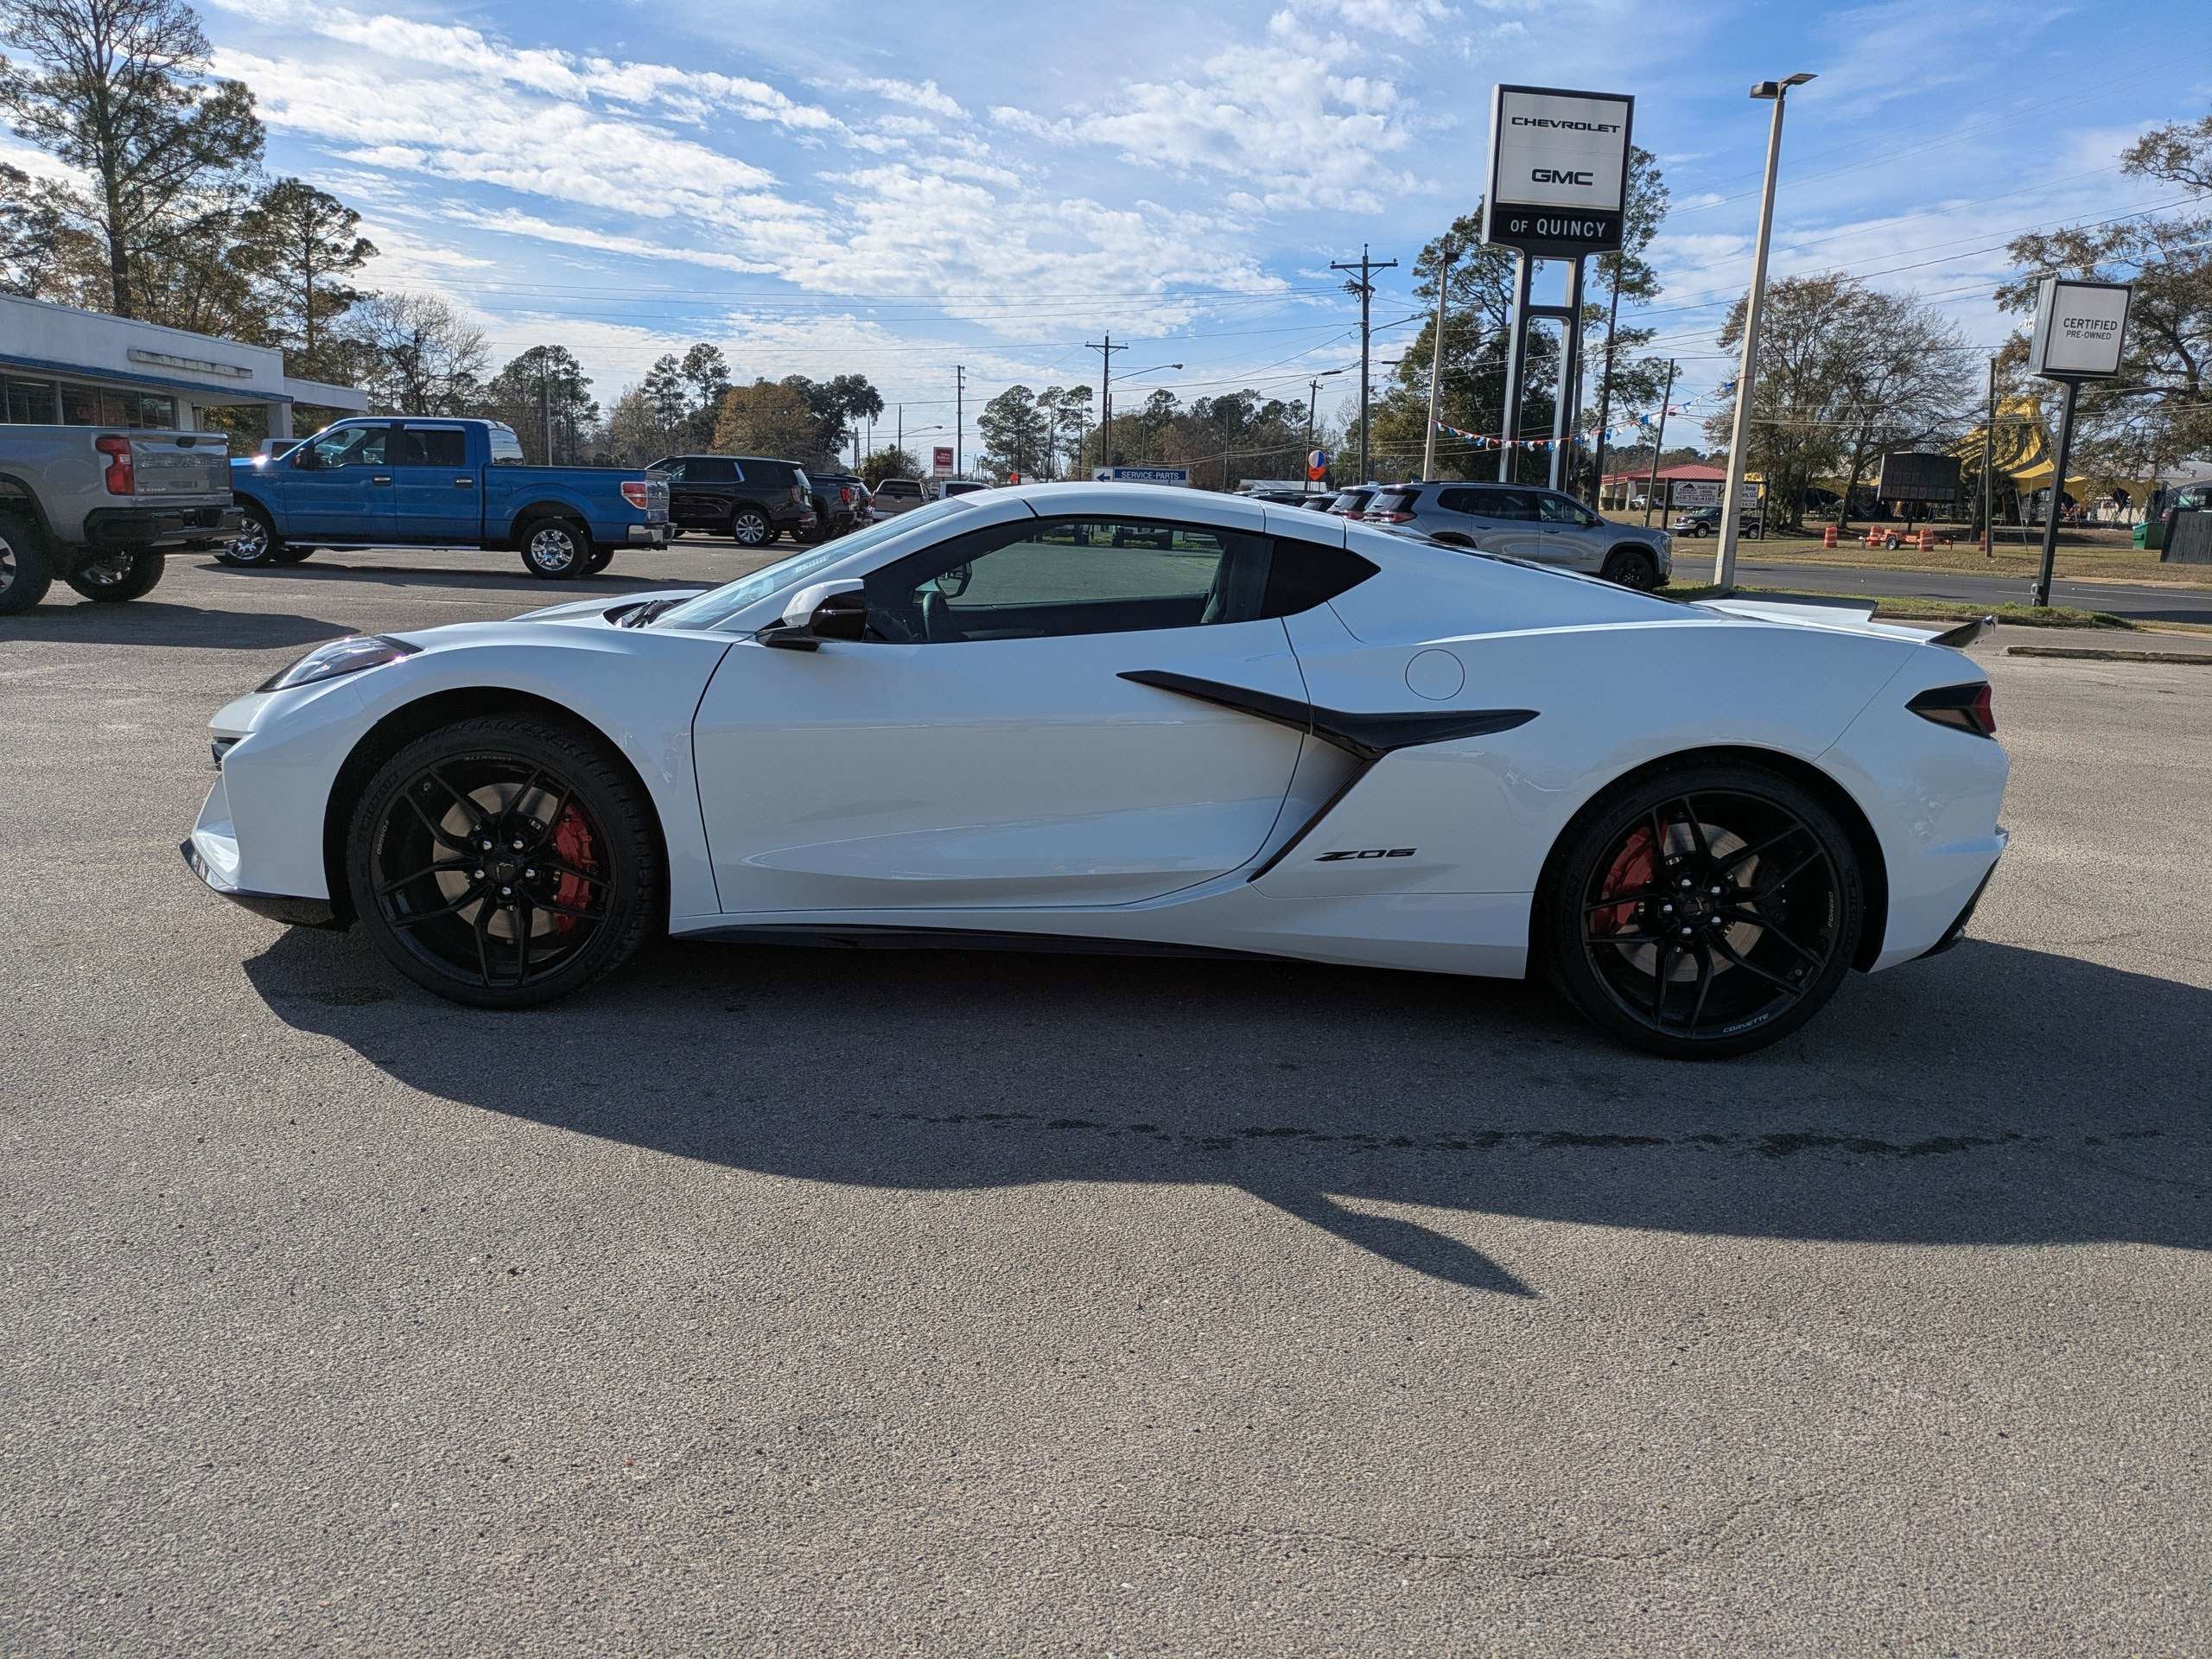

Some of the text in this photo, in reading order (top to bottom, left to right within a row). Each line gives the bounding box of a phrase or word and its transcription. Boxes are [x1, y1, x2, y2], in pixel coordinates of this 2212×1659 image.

[1511, 117, 1621, 133] CHEVROLET
[1531, 168, 1594, 187] GMC
[1510, 218, 1606, 238] OF QUINCY
[2063, 317, 2118, 331] CERTIFIED
[2065, 330, 2113, 340] PRE-OWNED
[1313, 848, 1418, 861] Z06
[1723, 1013, 1770, 1033] CORVETTE
